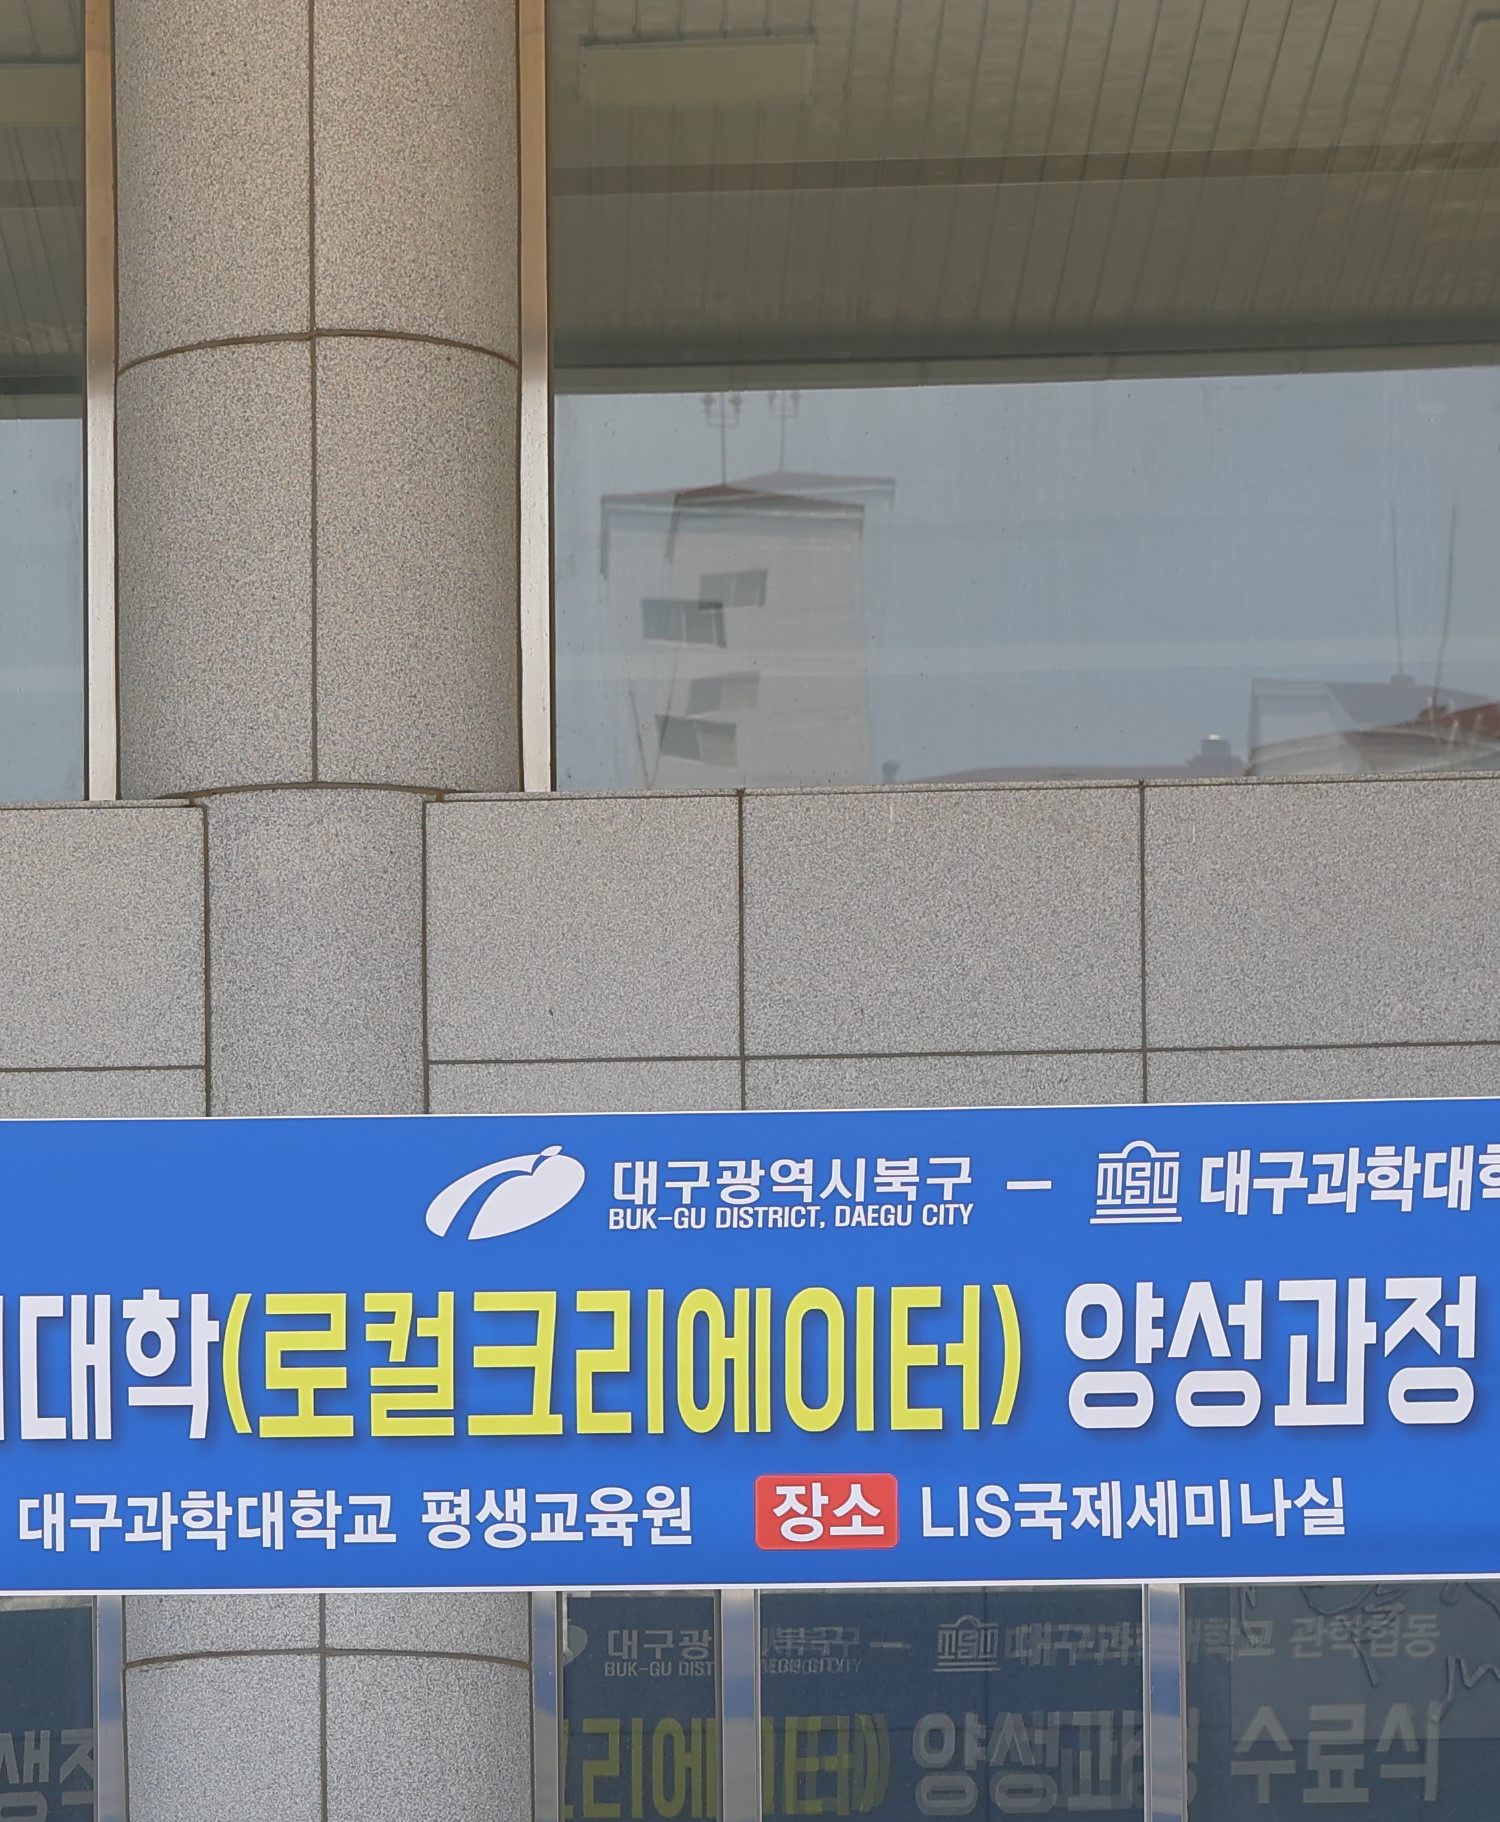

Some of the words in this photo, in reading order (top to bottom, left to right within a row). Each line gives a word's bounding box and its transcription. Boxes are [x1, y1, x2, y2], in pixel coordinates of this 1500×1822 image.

[613, 1157, 973, 1205] 대구광역시북구
[608, 1207, 706, 1230] BUK-GU
[715, 1205, 827, 1230] DISTRICT,
[835, 1204, 913, 1227] DAEGU
[922, 1203, 974, 1226] CITY
[1065, 1275, 1477, 1429] 양성과정
[19, 1489, 397, 1552] 대구과학대학교
[421, 1485, 692, 1549] 평생교육원
[772, 1482, 886, 1543] 장소
[921, 1477, 1345, 1540] LIS국제세미나실
